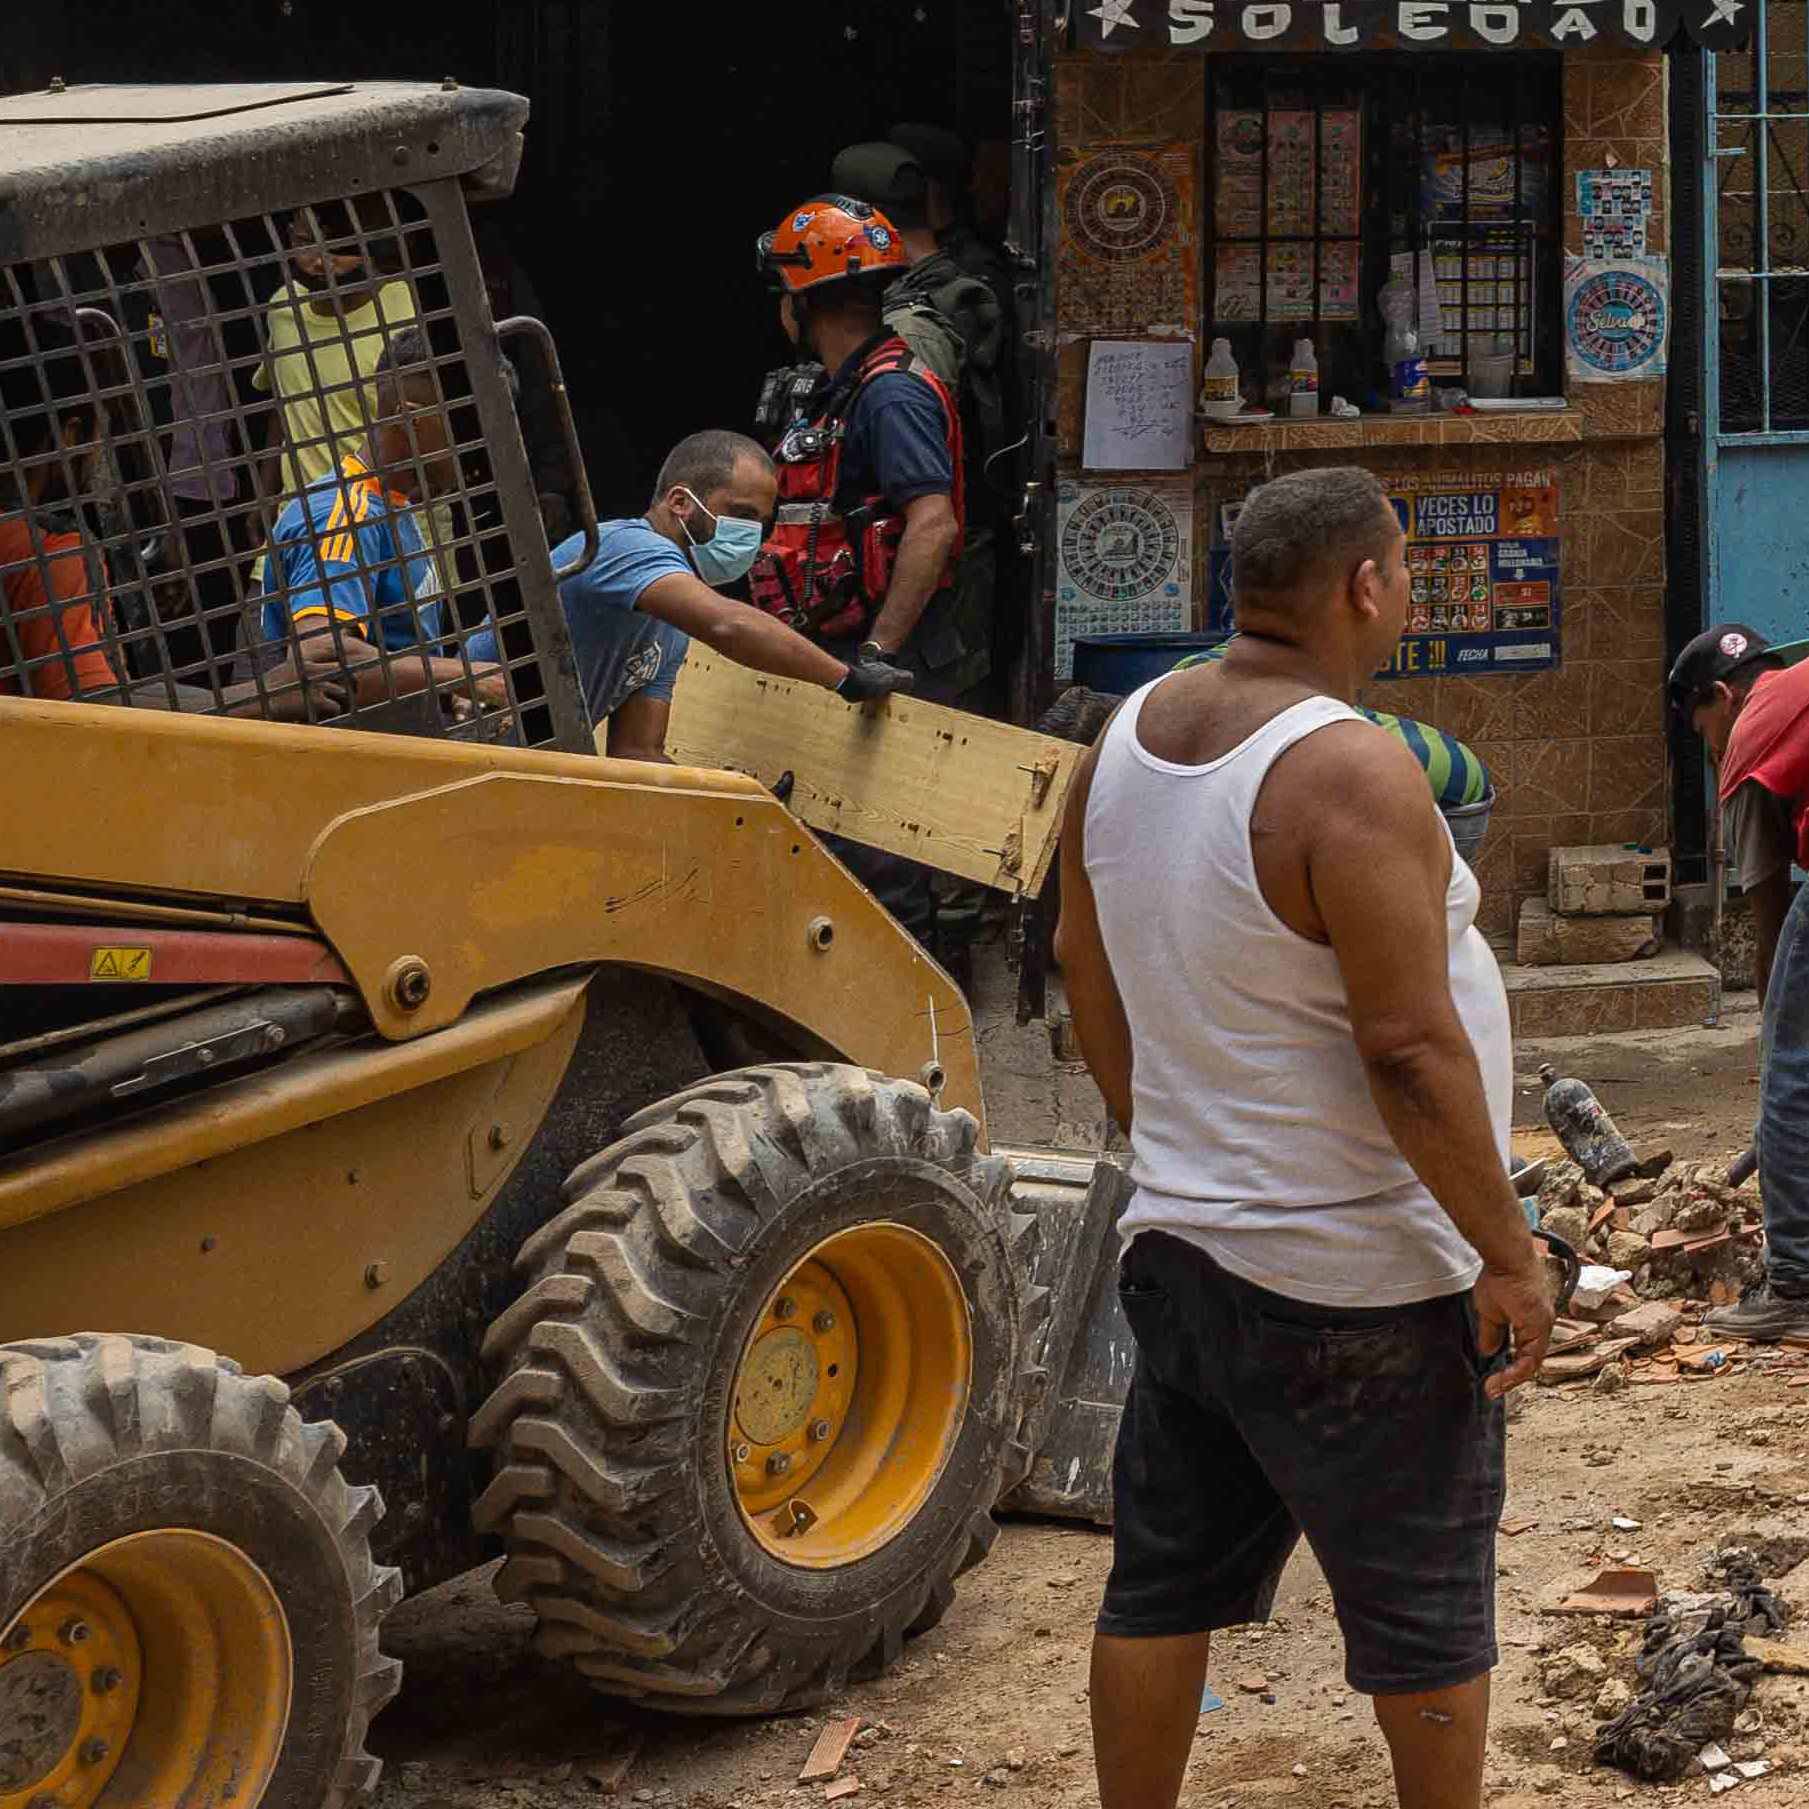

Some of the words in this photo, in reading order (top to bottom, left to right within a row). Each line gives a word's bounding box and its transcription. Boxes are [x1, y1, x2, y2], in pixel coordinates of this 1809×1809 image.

[1417, 496, 1469, 517] VECES
[1473, 494, 1495, 515] LO
[1416, 516, 1495, 537] APOSTADO
[1457, 647, 1490, 664] FECHA
